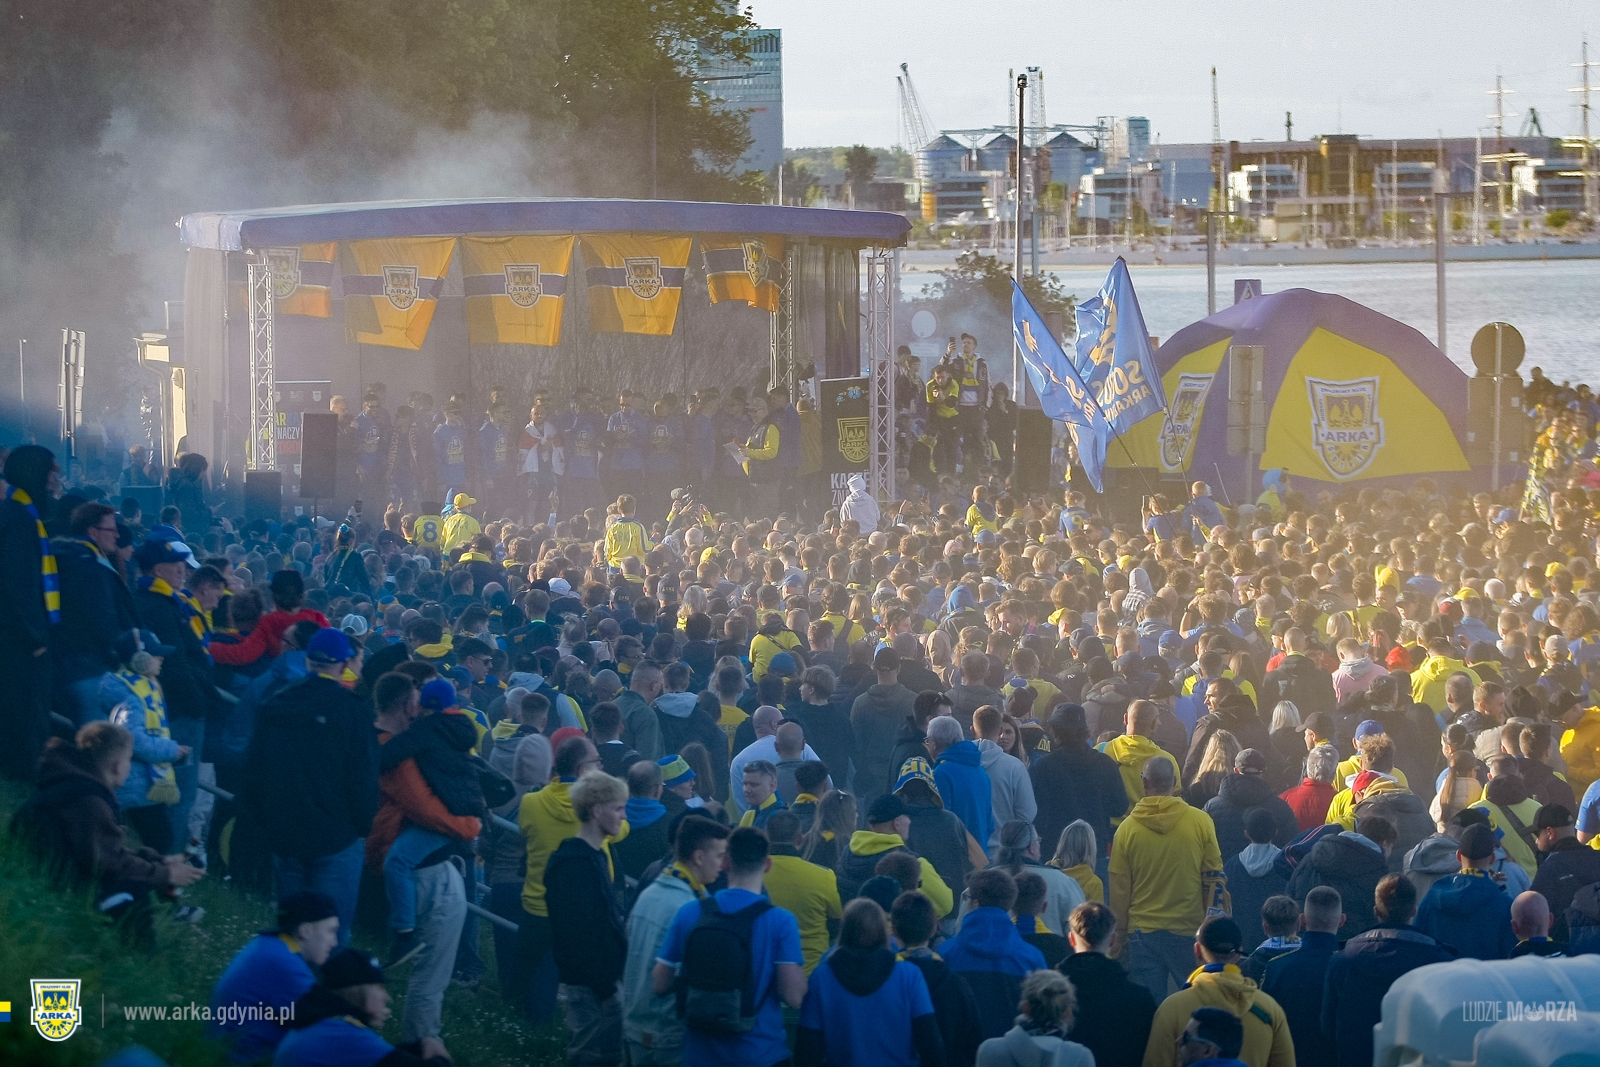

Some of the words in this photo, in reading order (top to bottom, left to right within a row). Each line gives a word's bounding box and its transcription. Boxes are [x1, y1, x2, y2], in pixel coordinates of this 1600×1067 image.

[277, 427, 300, 440] NACZY
[1325, 431, 1369, 442] ARKA
[423, 521, 438, 543] 8
